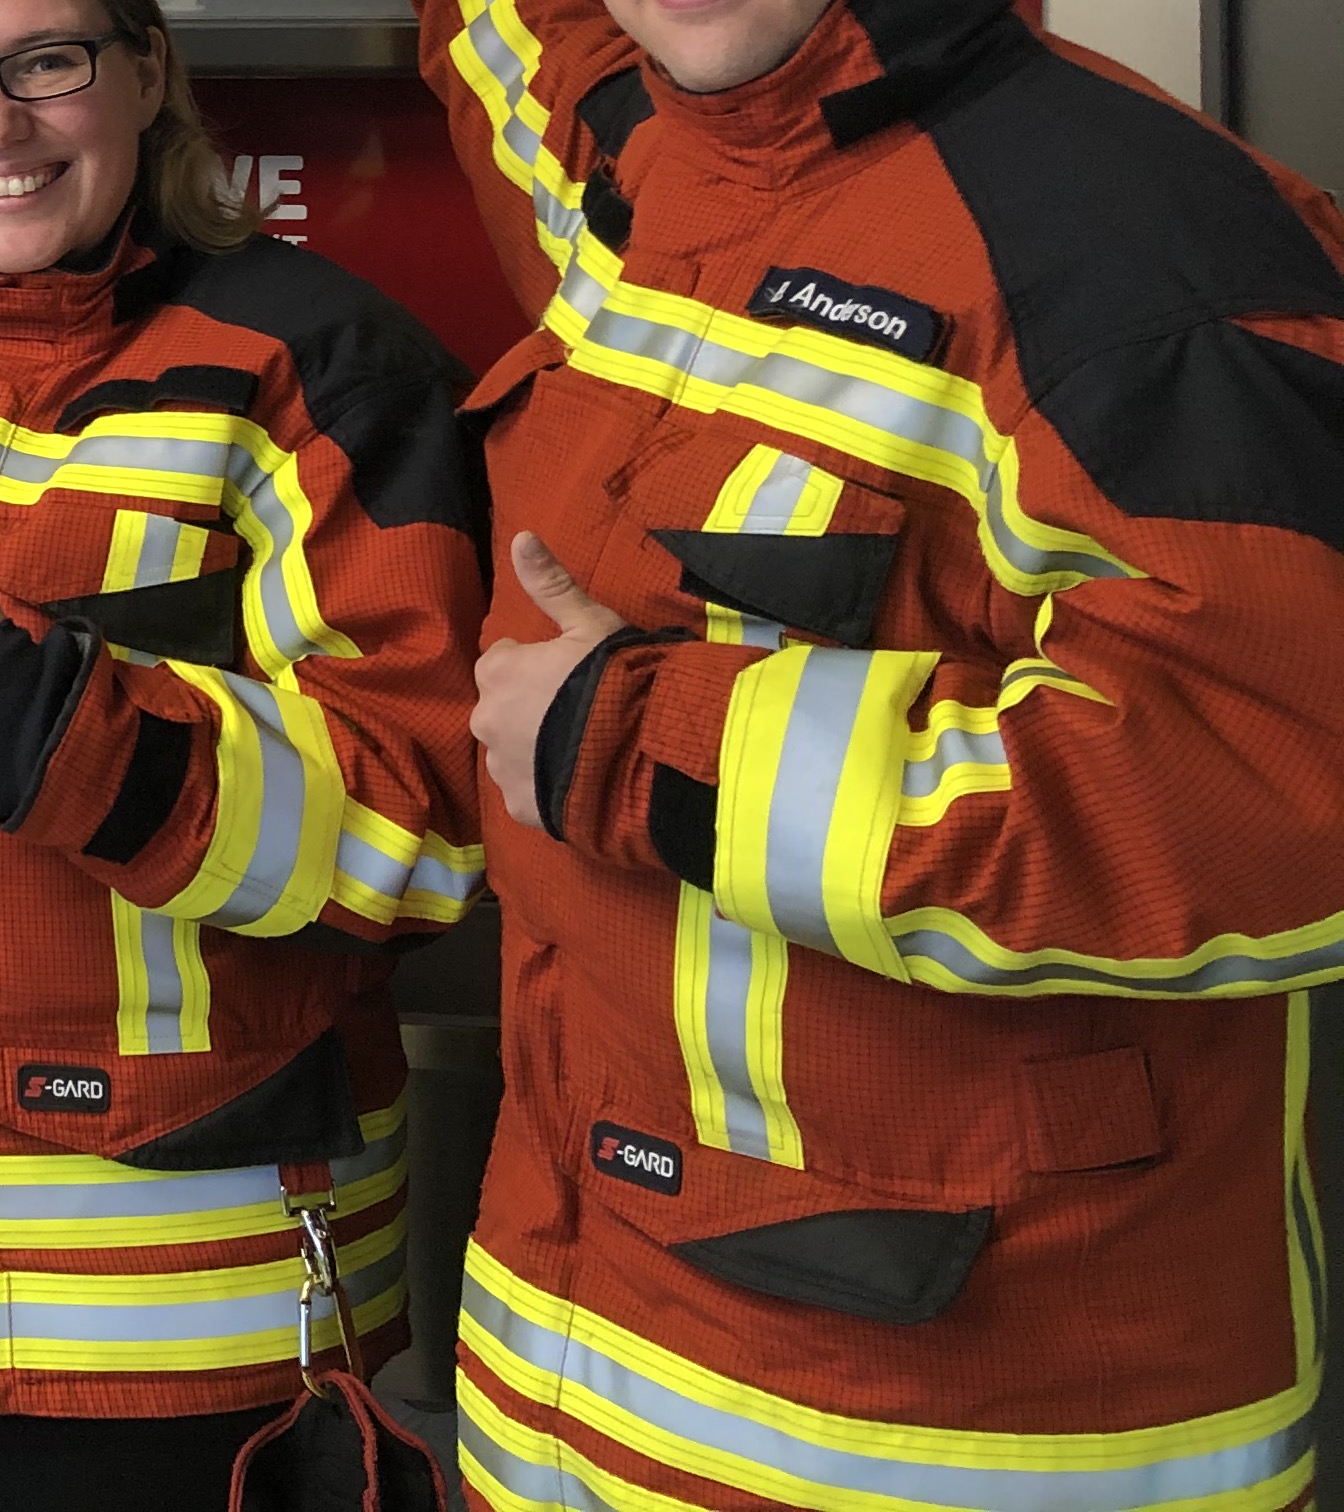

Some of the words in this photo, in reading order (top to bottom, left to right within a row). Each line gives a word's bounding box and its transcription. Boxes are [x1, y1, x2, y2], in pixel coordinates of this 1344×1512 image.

[214, 155, 308, 220] WE
[24, 1076, 104, 1100] S-GARD
[596, 1136, 675, 1179] S-GARD
